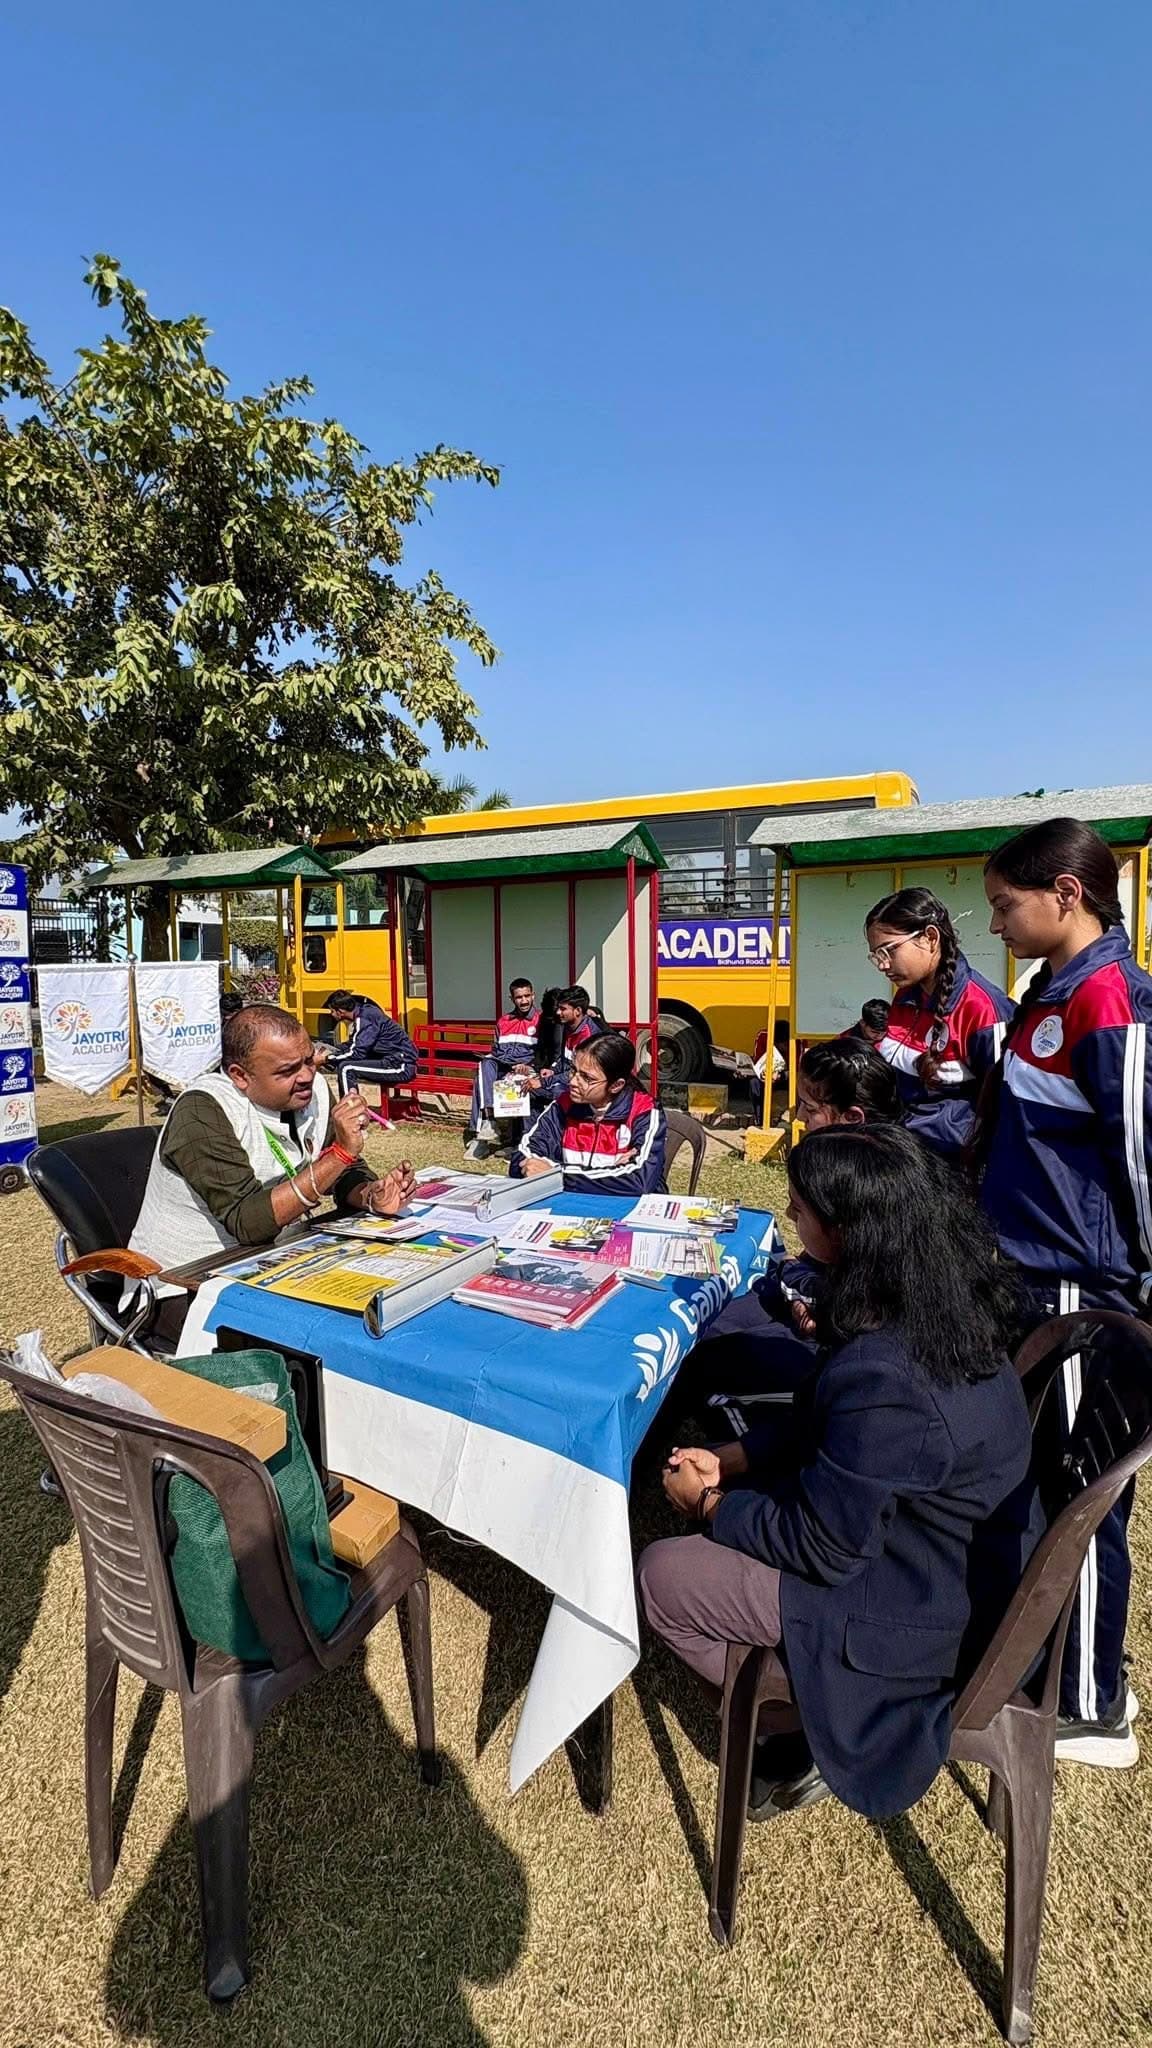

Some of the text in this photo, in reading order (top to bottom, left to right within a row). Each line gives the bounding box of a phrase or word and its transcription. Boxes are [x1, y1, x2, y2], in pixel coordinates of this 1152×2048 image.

[657, 926, 791, 959] ACADEM
[745, 958, 766, 966] Road,
[72, 1030, 125, 1045] JAYOTRI
[168, 1024, 216, 1039] JAYOTRI
[168, 1036, 216, 1049] ACADEMY
[72, 1043, 125, 1056] ACADEMY
[4, 1122, 30, 1131] JAYOTRI
